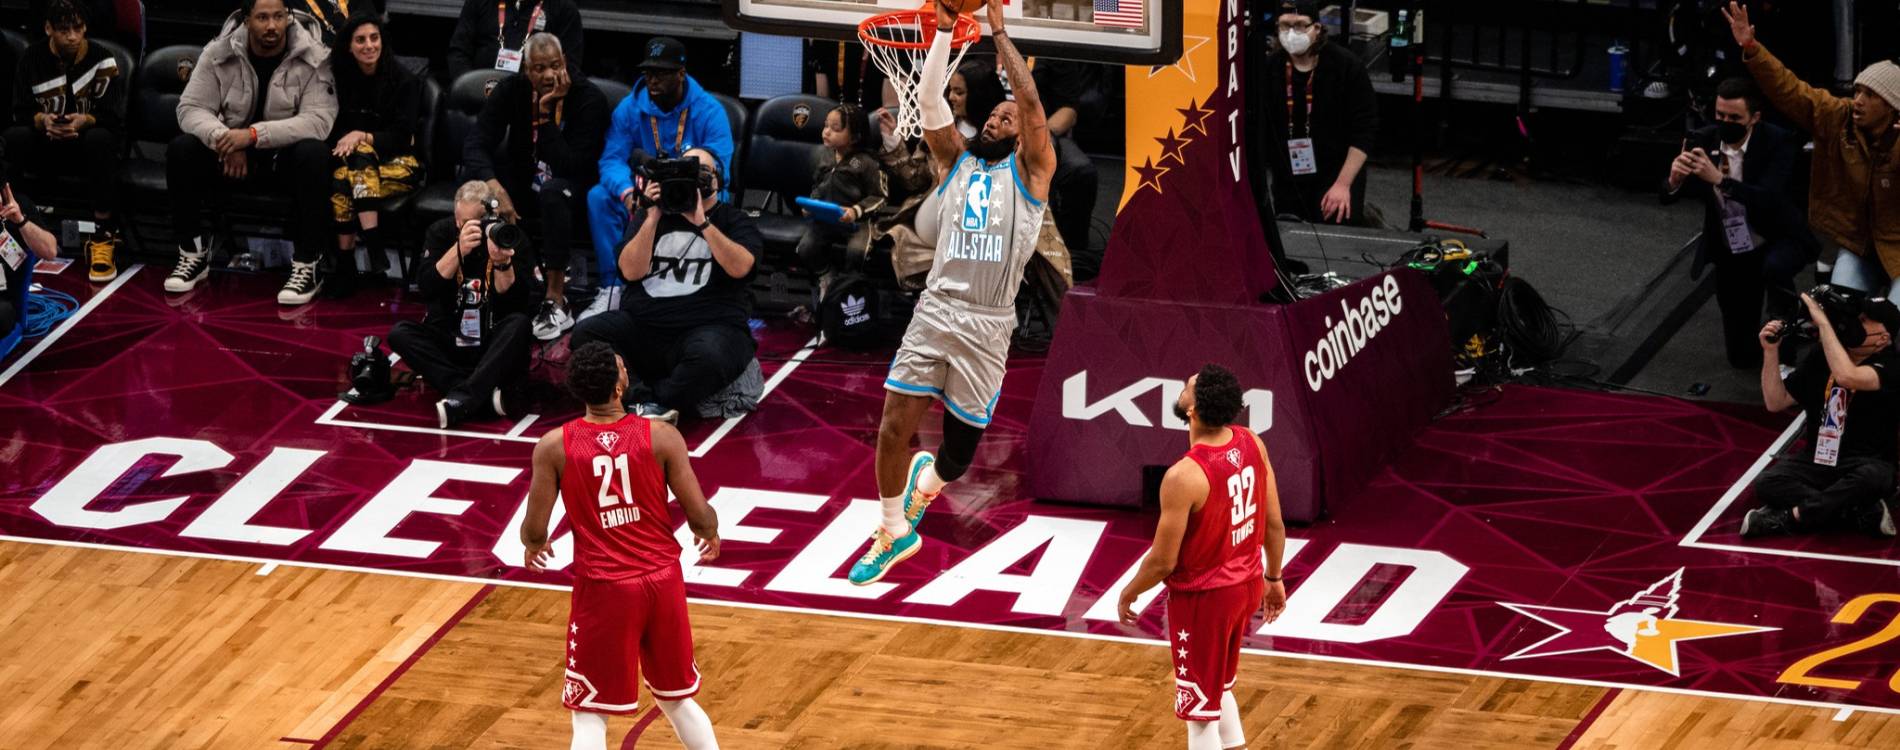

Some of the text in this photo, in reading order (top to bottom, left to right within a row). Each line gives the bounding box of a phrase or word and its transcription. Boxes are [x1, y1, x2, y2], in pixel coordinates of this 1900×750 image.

[1227, 0, 1240, 182] NBA TV
[947, 231, 1003, 262] ALL-STAR
[965, 217, 979, 228] NBA
[1304, 274, 1402, 392] coinbase
[592, 453, 634, 508] 21
[1227, 465, 1257, 526] 32
[29, 436, 1471, 644] CLEELAD
[599, 506, 641, 529] EMBIID
[1775, 592, 1900, 694] 2
